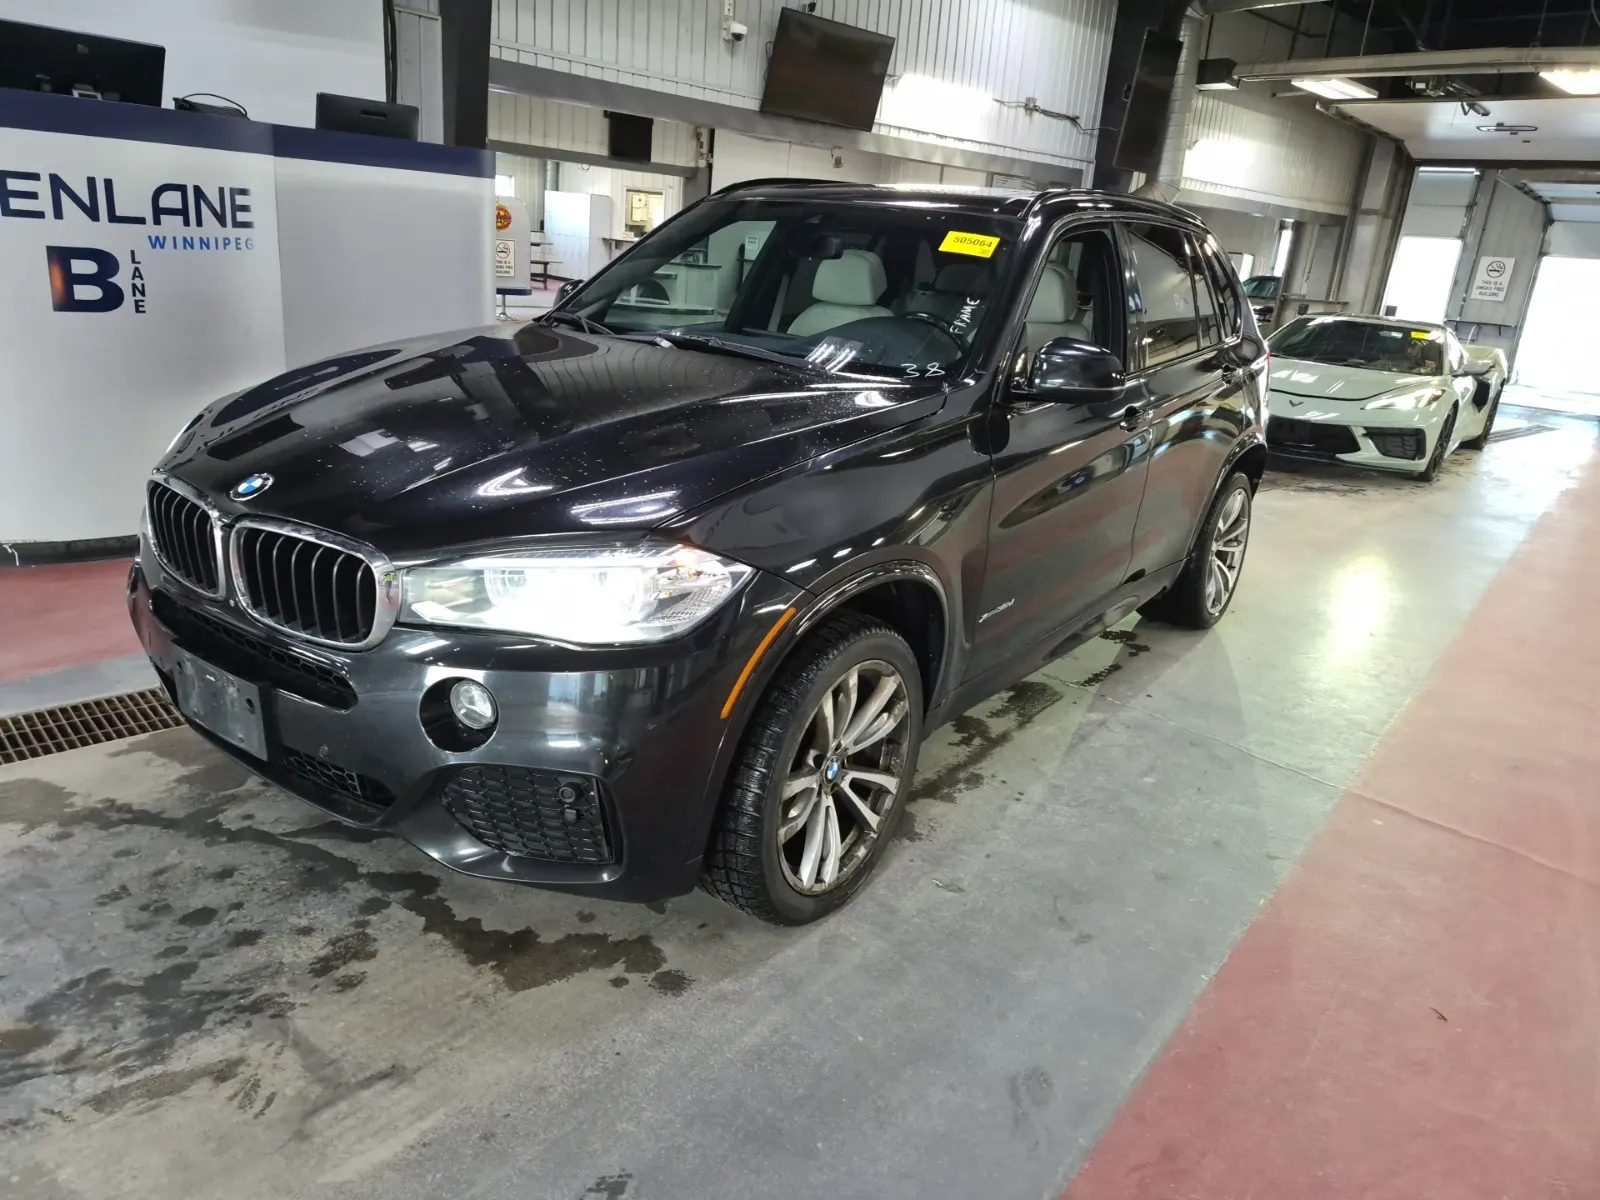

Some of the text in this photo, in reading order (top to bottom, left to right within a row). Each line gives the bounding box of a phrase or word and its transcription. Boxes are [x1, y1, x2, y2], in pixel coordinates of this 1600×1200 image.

[0, 170, 254, 229] ENLANE
[148, 235, 254, 251] WINNIPEG
[953, 236, 993, 248] 505064
[46, 245, 146, 314] B LANE
[949, 297, 980, 334] FRAME
